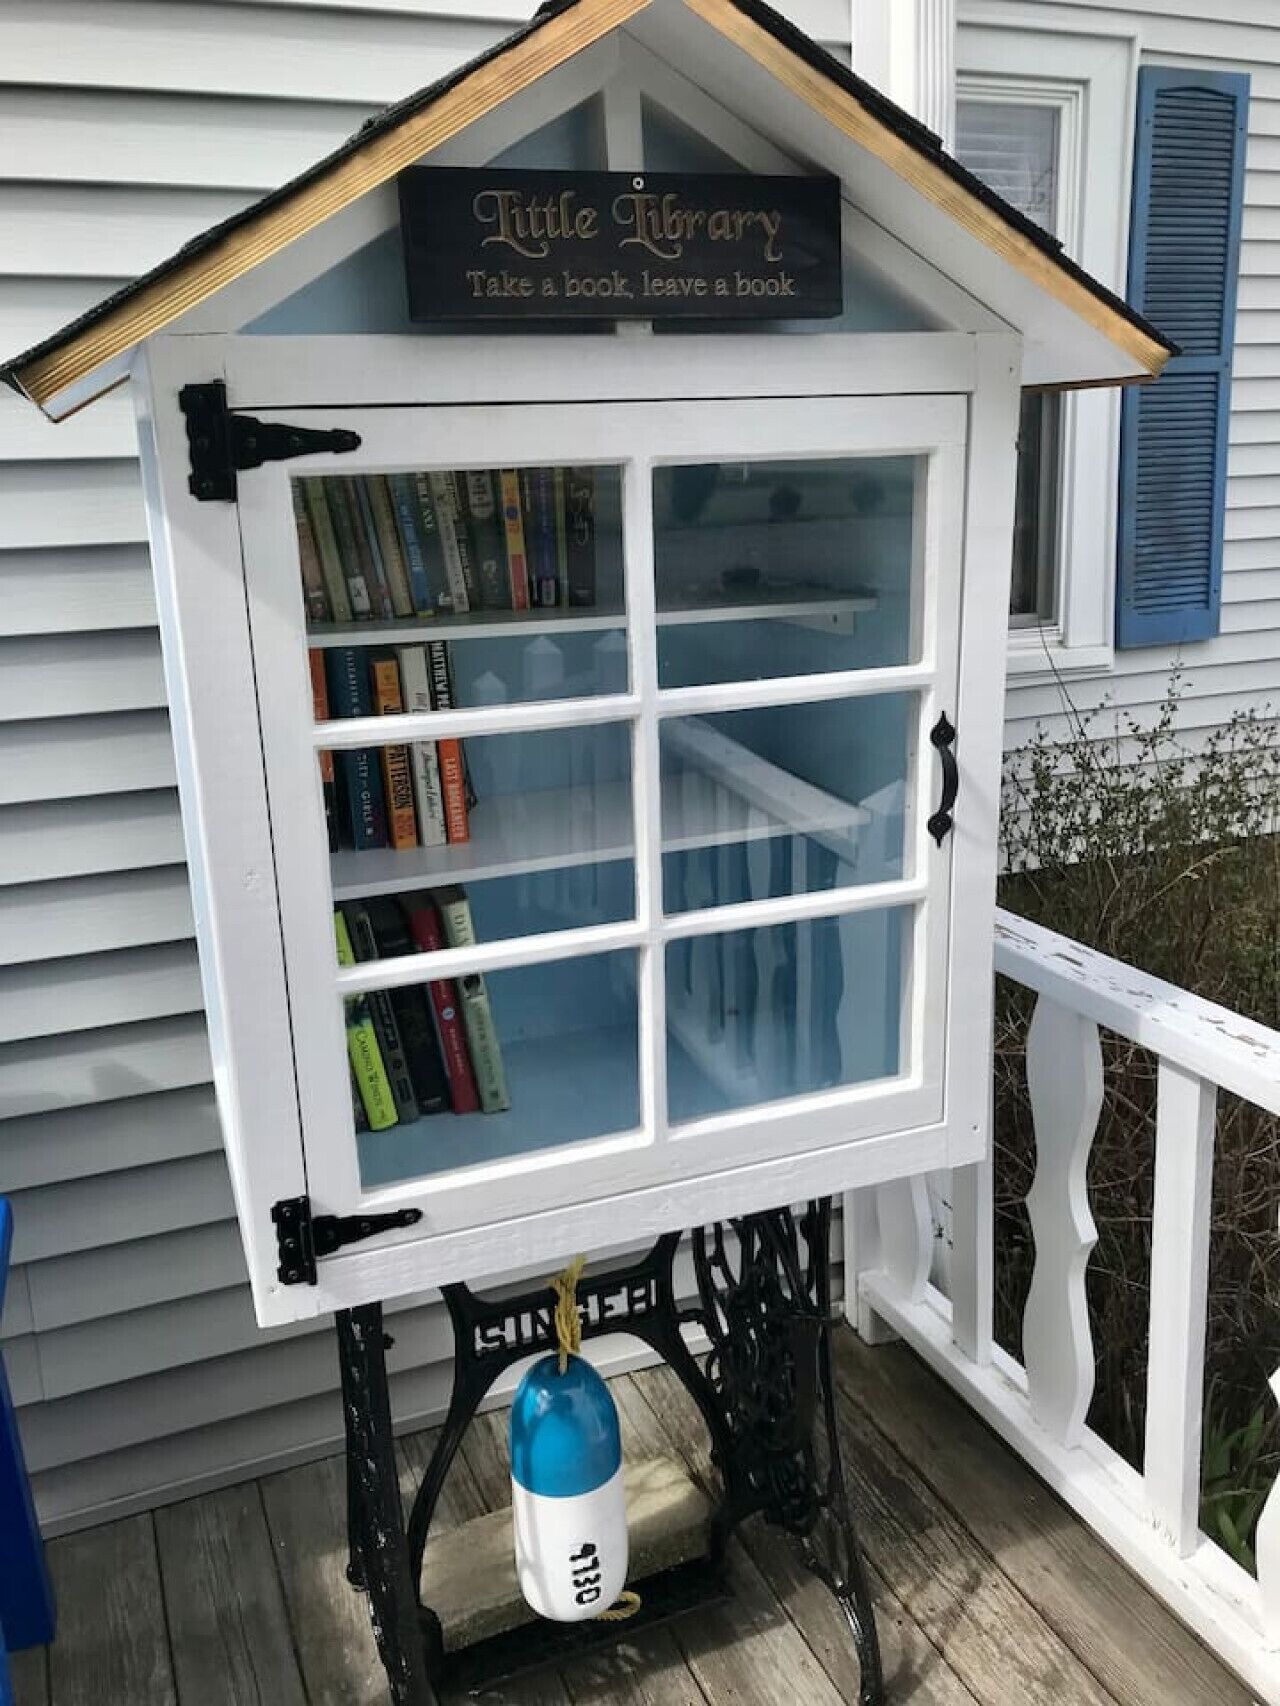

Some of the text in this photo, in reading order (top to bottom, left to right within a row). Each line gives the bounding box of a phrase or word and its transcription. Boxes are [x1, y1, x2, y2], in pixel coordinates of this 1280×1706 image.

[471, 189, 784, 262] Little Library
[466, 270, 796, 299] Take a book, leave a book
[568, 1542, 601, 1606] 9730
